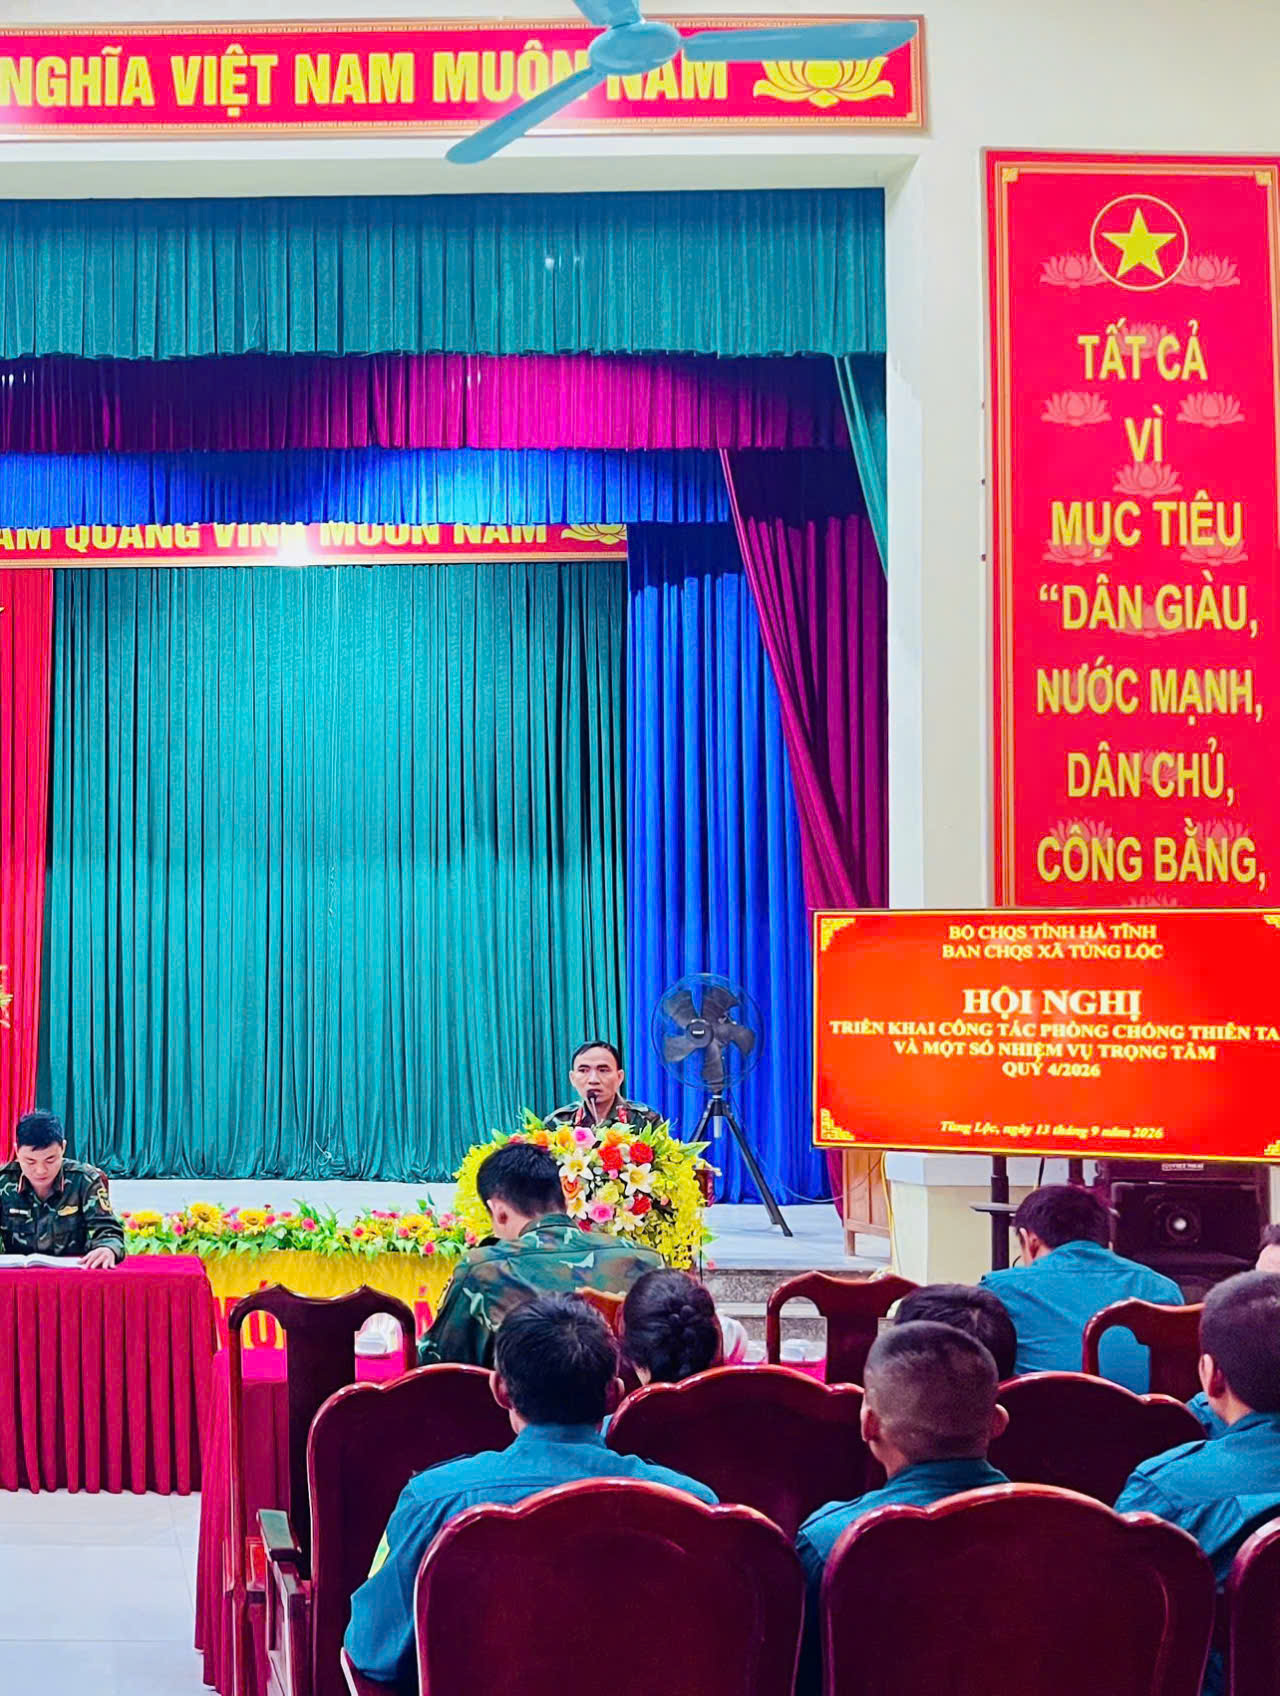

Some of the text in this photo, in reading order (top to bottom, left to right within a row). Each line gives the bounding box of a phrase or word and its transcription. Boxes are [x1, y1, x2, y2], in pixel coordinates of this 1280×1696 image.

[170, 44, 278, 117] VIỆT
[295, 52, 414, 105] NAM
[1078, 318, 1207, 380] TẤT CẢ
[1125, 405, 1163, 462] VÌ
[1052, 490, 1241, 558] MỤC TIÊU
[1155, 570, 1257, 638] GIÀU,
[1037, 656, 1262, 725] NƯỚC MẠNH,
[1068, 737, 1234, 805] DÂN CHỦ,
[1037, 817, 1265, 890] CÔNG BẰNG,
[942, 940, 1164, 962] BAN CHQS XÃ TÙNG LỘC
[948, 924, 976, 942] BỘ
[977, 925, 1028, 943] CHQS
[1077, 922, 1107, 941] HÀ
[887, 1020, 937, 1037] KHAI
[937, 1017, 995, 1038] CÔNG
[996, 1018, 1038, 1039] TÁC
[1039, 1019, 1110, 1041] PHÒNG
[1187, 1021, 1251, 1041] THIÊN
[1254, 1026, 1280, 1041] TA
[962, 985, 1142, 1024] HỘI NGHỊ
[892, 1036, 920, 1056] VÀ
[922, 1039, 968, 1059] MỘT
[997, 1040, 1064, 1062] NHIỆM
[1065, 1042, 1094, 1062] VỤ
[1096, 1043, 1168, 1063] TRỌNG
[1170, 1041, 1217, 1061] TÂM
[1047, 1062, 1102, 1078] 4/2026
[1035, 1123, 1051, 1136] 13
[1090, 1125, 1100, 1137] 9
[1131, 1126, 1164, 1139] 2026
